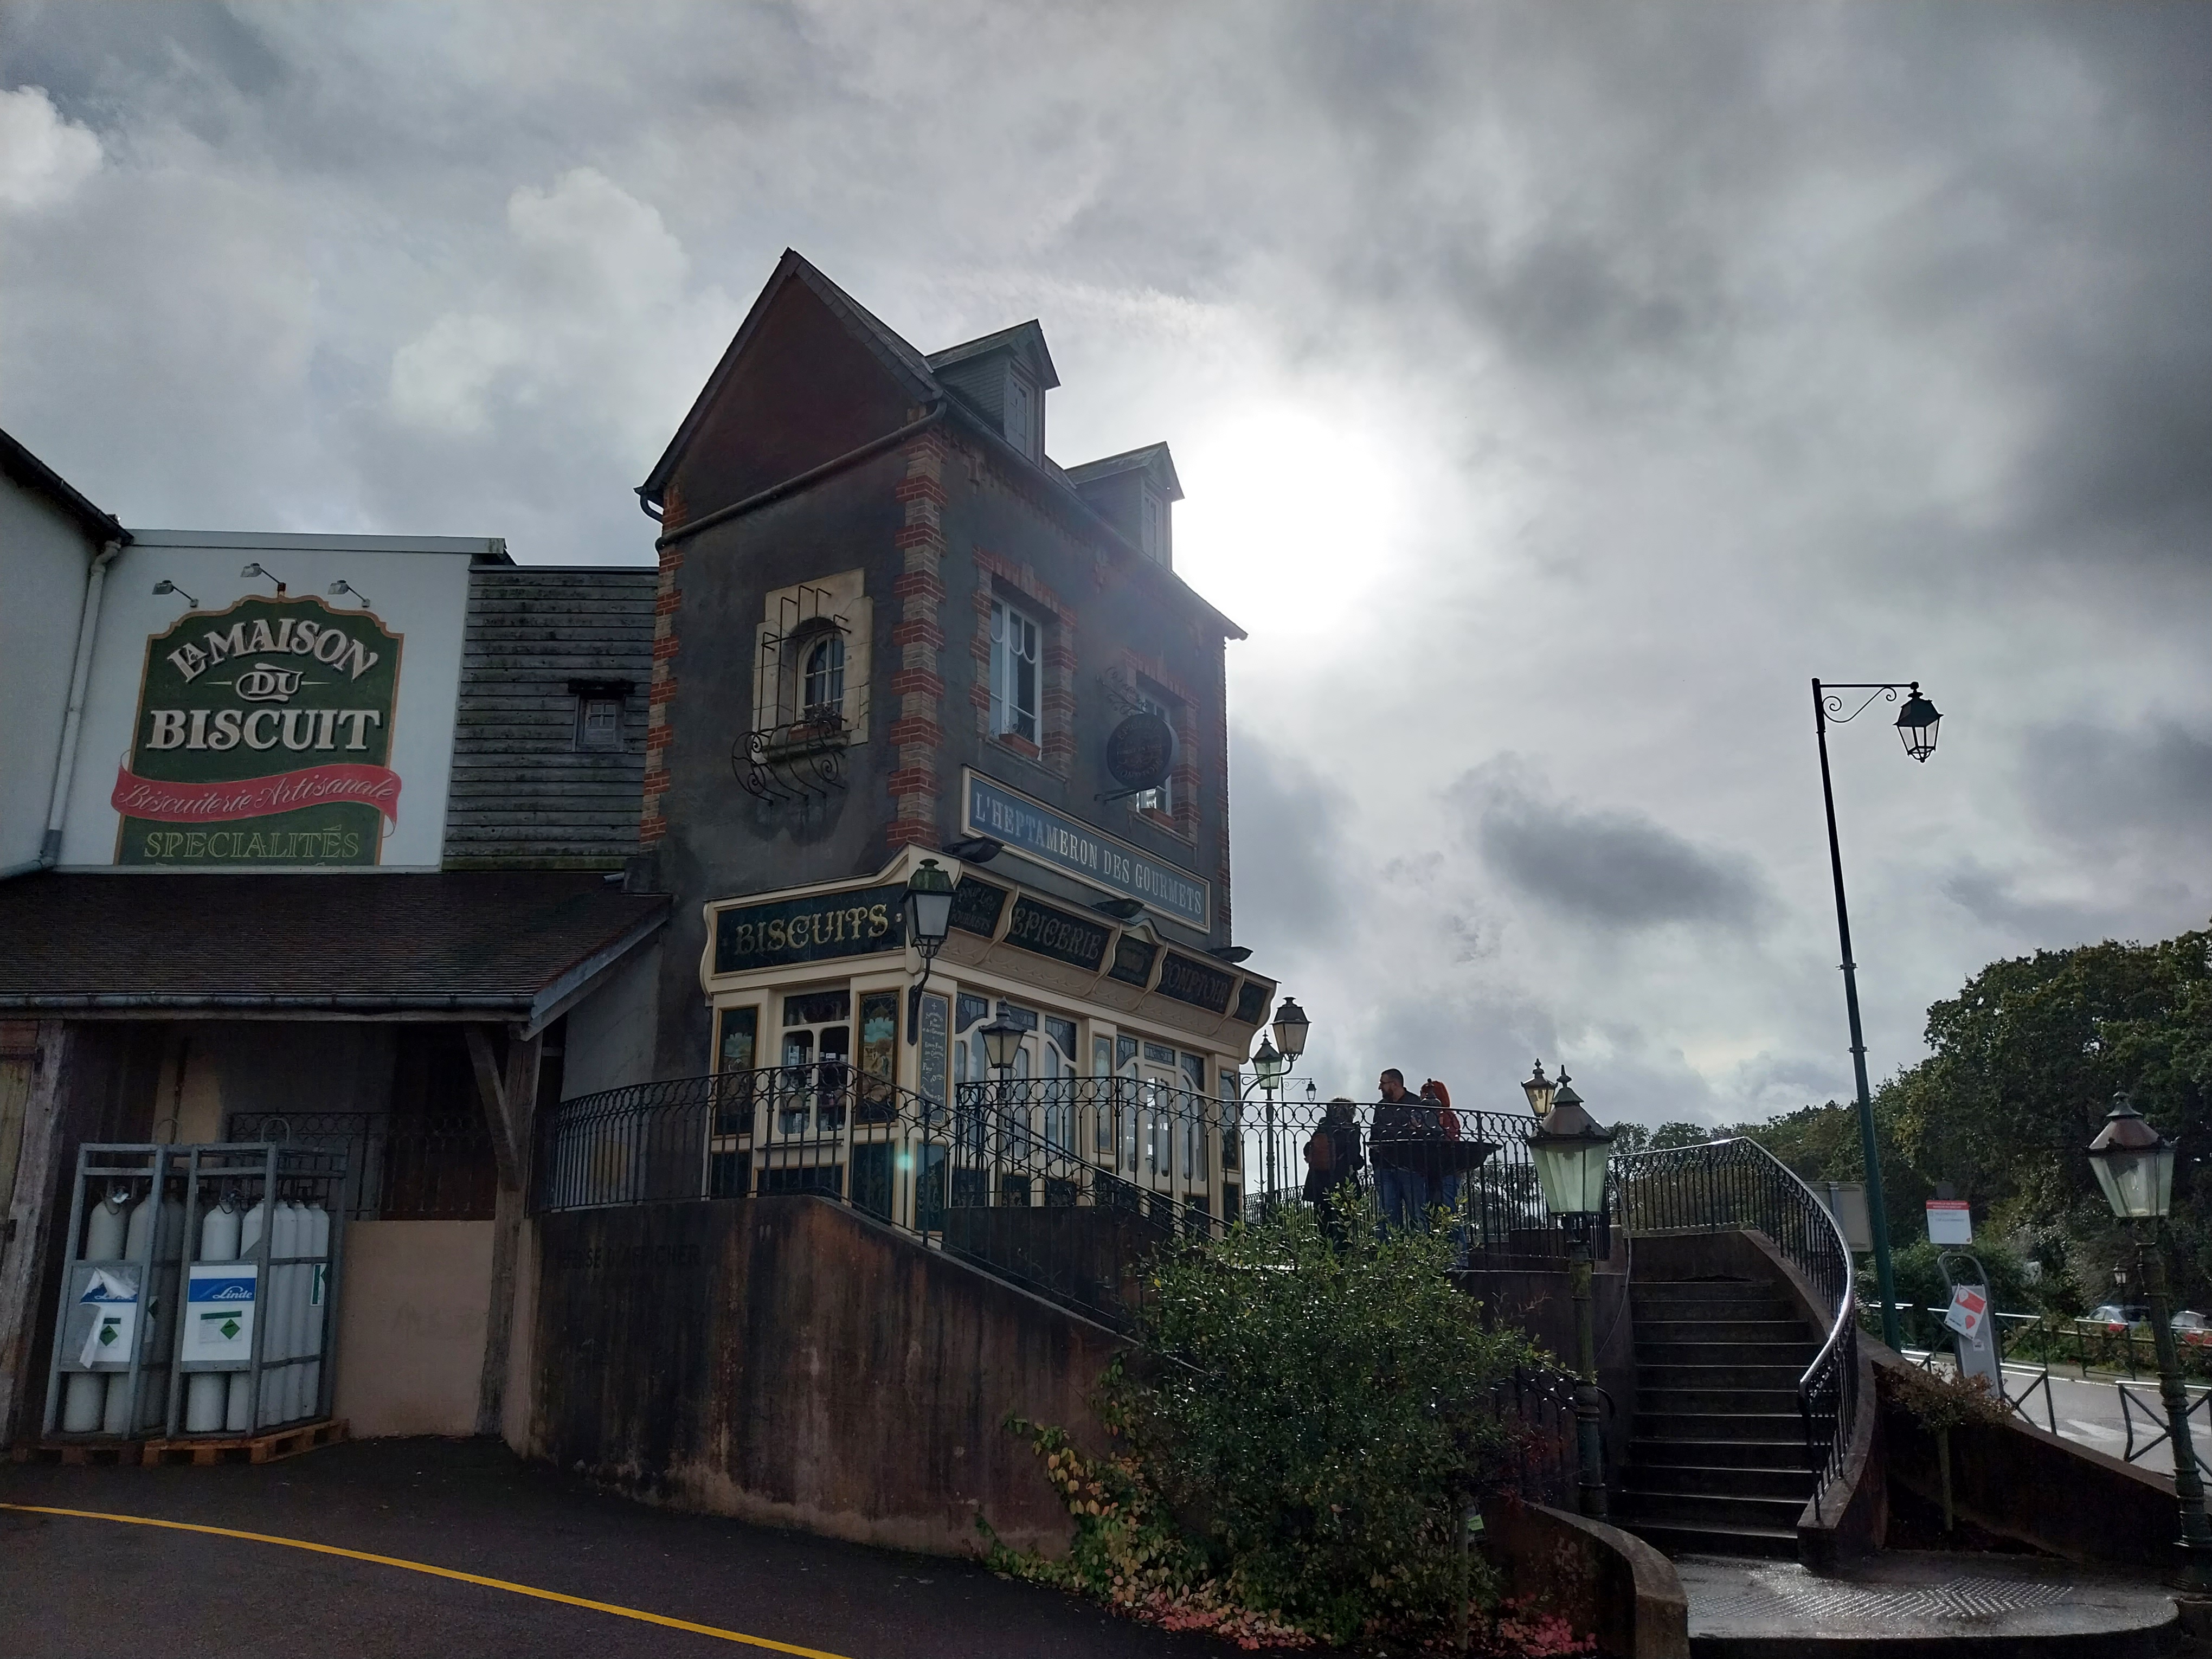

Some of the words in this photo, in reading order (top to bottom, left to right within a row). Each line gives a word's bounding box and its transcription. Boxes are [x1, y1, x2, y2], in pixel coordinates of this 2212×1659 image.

[167, 642, 209, 683] LA
[204, 618, 378, 682] MAISON
[236, 663, 304, 702] DU
[145, 709, 382, 752] BISCUIT
[117, 784, 252, 814] Biscuiterie
[255, 774, 395, 808] Artisanale
[975, 792, 1097, 870] L'HEPTAMERON
[1104, 850, 1129, 883] DES
[1135, 863, 1201, 914] GOURMETS
[734, 903, 889, 955] BISCUITS
[213, 1286, 252, 1299] Linde
